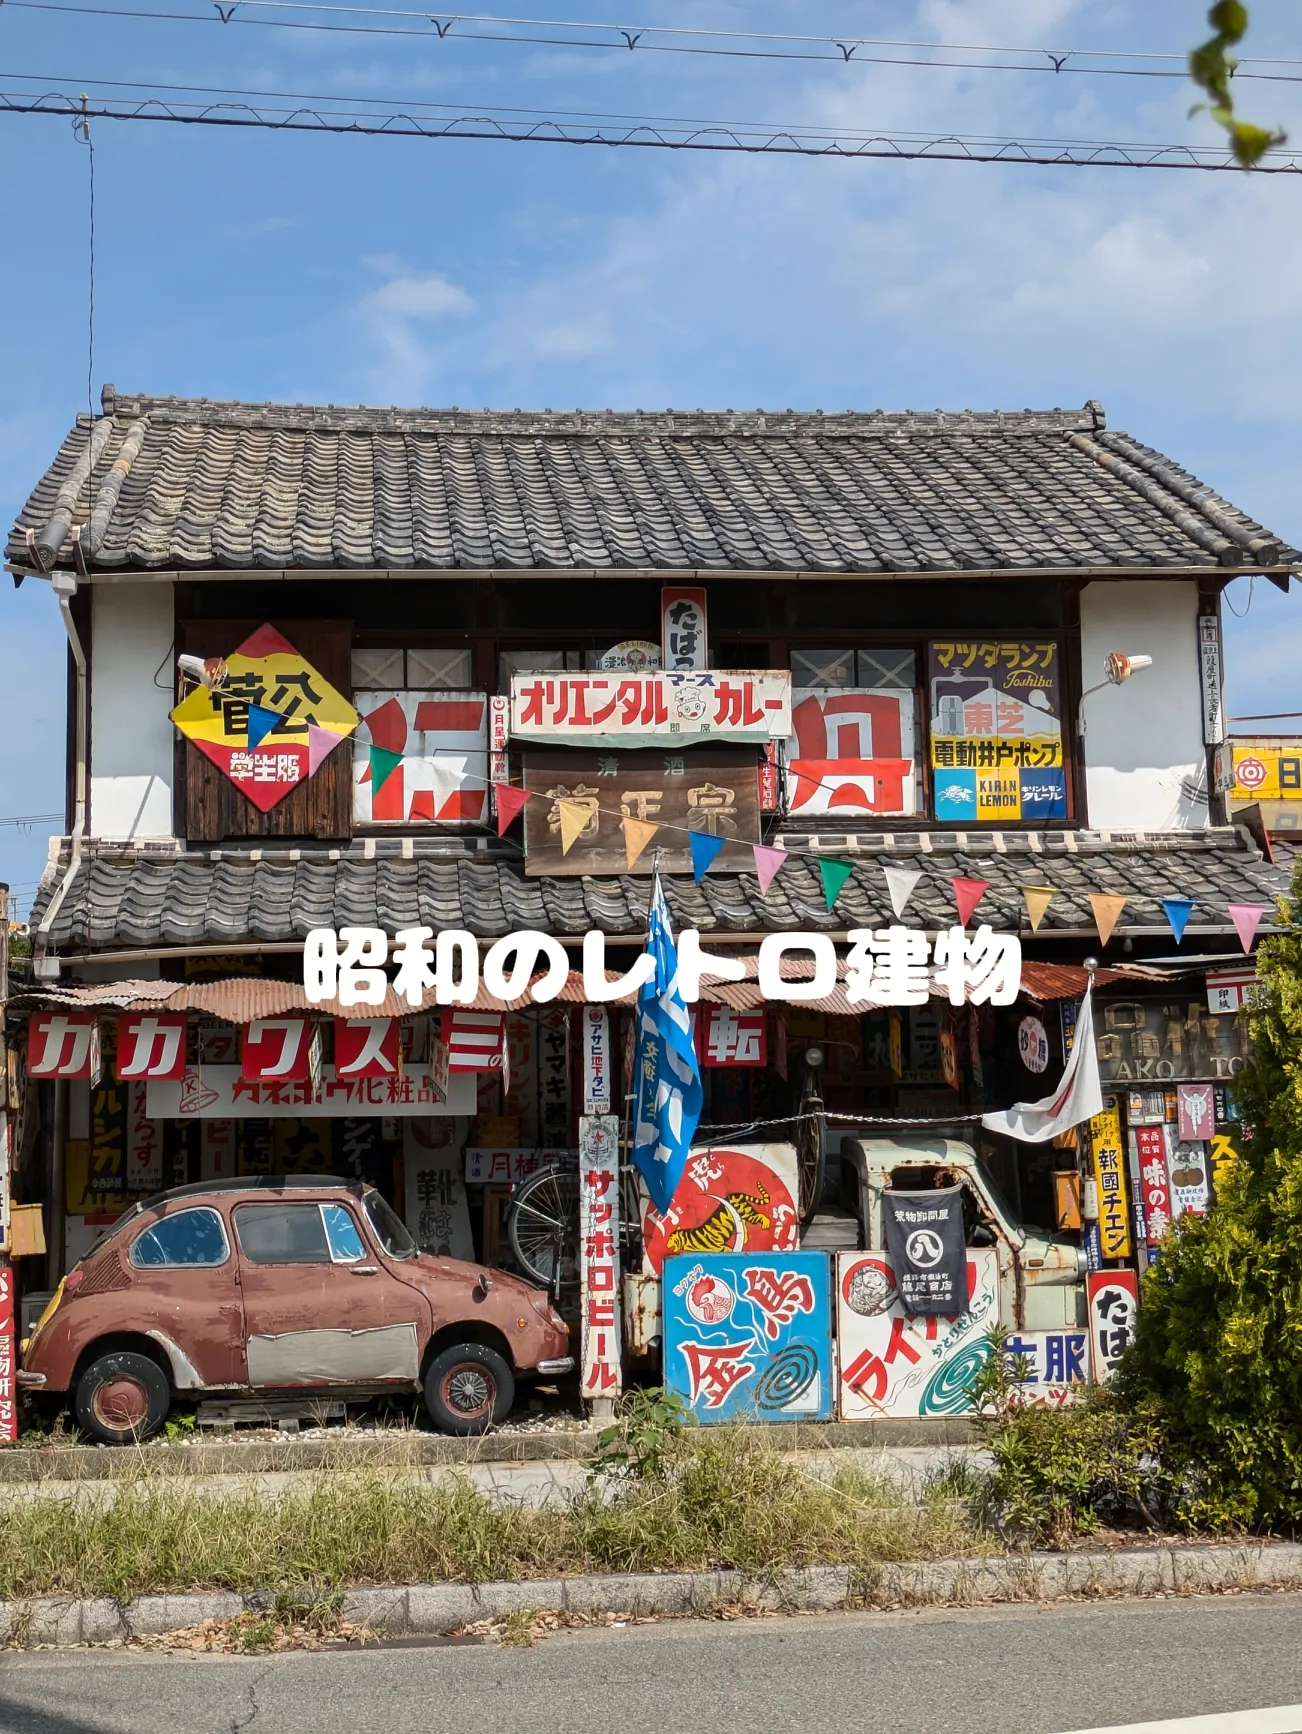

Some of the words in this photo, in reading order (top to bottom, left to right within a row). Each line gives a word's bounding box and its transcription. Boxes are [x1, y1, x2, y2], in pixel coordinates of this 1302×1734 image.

[932, 642, 1058, 669] マツダランプ
[665, 673, 717, 687] マース
[1002, 669, 1054, 689] Toshiba
[519, 680, 668, 725] オリエンタル
[712, 681, 783, 726] カレー
[963, 701, 1025, 735] 東芝
[597, 756, 685, 777] 清酒
[934, 740, 1061, 768] 電動井戸ポンプ
[979, 780, 1017, 791] KIRIN
[1021, 785, 1062, 793] キリンレモン
[1021, 791, 1064, 802] クレール
[979, 795, 1017, 807] LEMON
[31, 1016, 90, 1074] カ
[121, 1017, 183, 1076] カ
[247, 1018, 305, 1076] ワ
[338, 1017, 397, 1074] ス
[708, 1005, 763, 1062] 転
[590, 1024, 605, 1097] アサヒ地下タビ
[1098, 1148, 1126, 1253] 報國チエン
[1143, 1157, 1170, 1240] 味の素
[583, 1170, 617, 1390] サッポロビール
